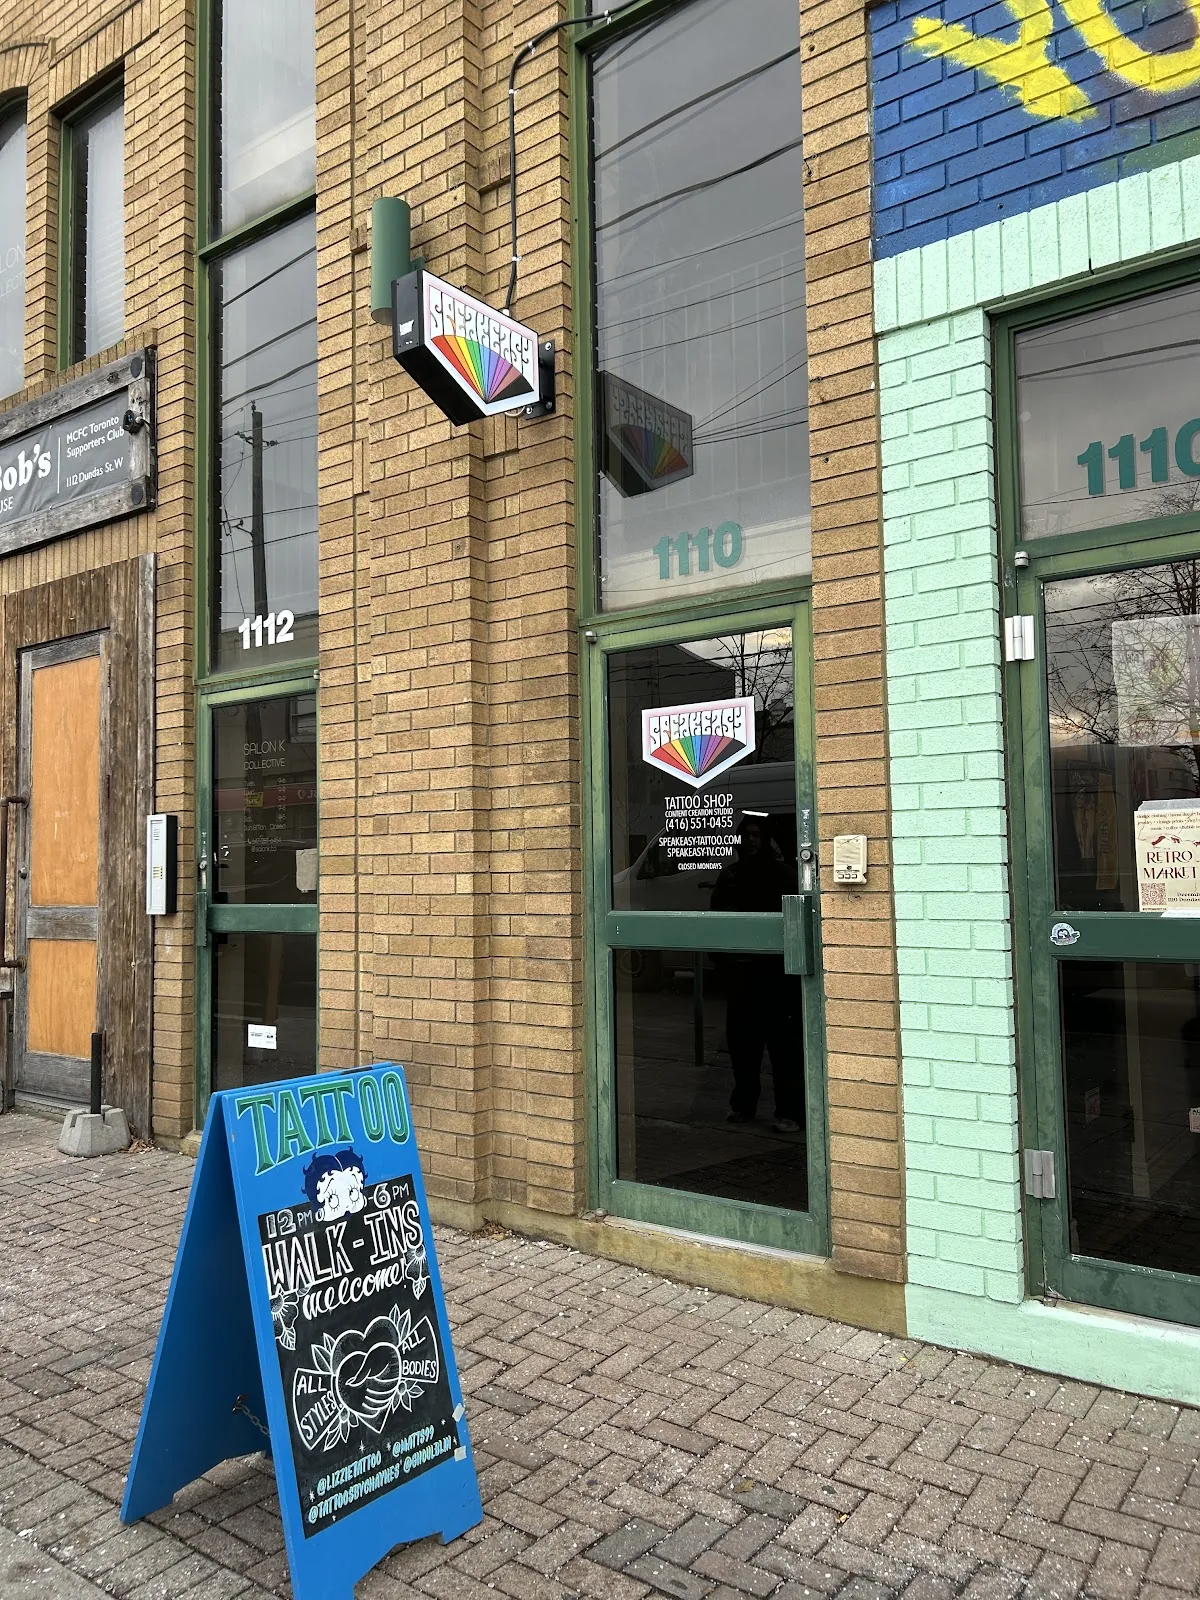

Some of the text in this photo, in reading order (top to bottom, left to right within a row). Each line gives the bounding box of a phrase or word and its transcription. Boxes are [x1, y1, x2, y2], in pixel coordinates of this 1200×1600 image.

[66, 416, 120, 445] MCFC Toronto
[66, 426, 125, 458] Supporters Club
[0, 443, 52, 492] ob's
[79, 466, 104, 483] Dundas
[114, 456, 124, 469] W
[653, 520, 743, 580] 1110
[238, 609, 295, 650] 1112
[243, 740, 286, 756] SALON K
[244, 758, 286, 770] COLLECTIVE
[664, 793, 733, 810] TATTOO SHOP
[664, 807, 734, 818] CONTENT CREATION STUDIO
[665, 815, 733, 832] (416) 551-0455
[658, 834, 742, 847] SPEAKEASY-TATTOO.COM
[667, 846, 733, 858] SPEAKEASY-TV.COM
[1146, 850, 1193, 864] RETRO
[677, 862, 723, 871] CLOSED MONDAYS
[1143, 866, 1197, 880] MARKET
[234, 1071, 410, 1176] TATTOO
[402, 1329, 427, 1354] ALL
[402, 1358, 437, 1378] BODIES
[296, 1375, 328, 1396] ALL
[316, 1450, 382, 1496] @LIZZIETATTOO
